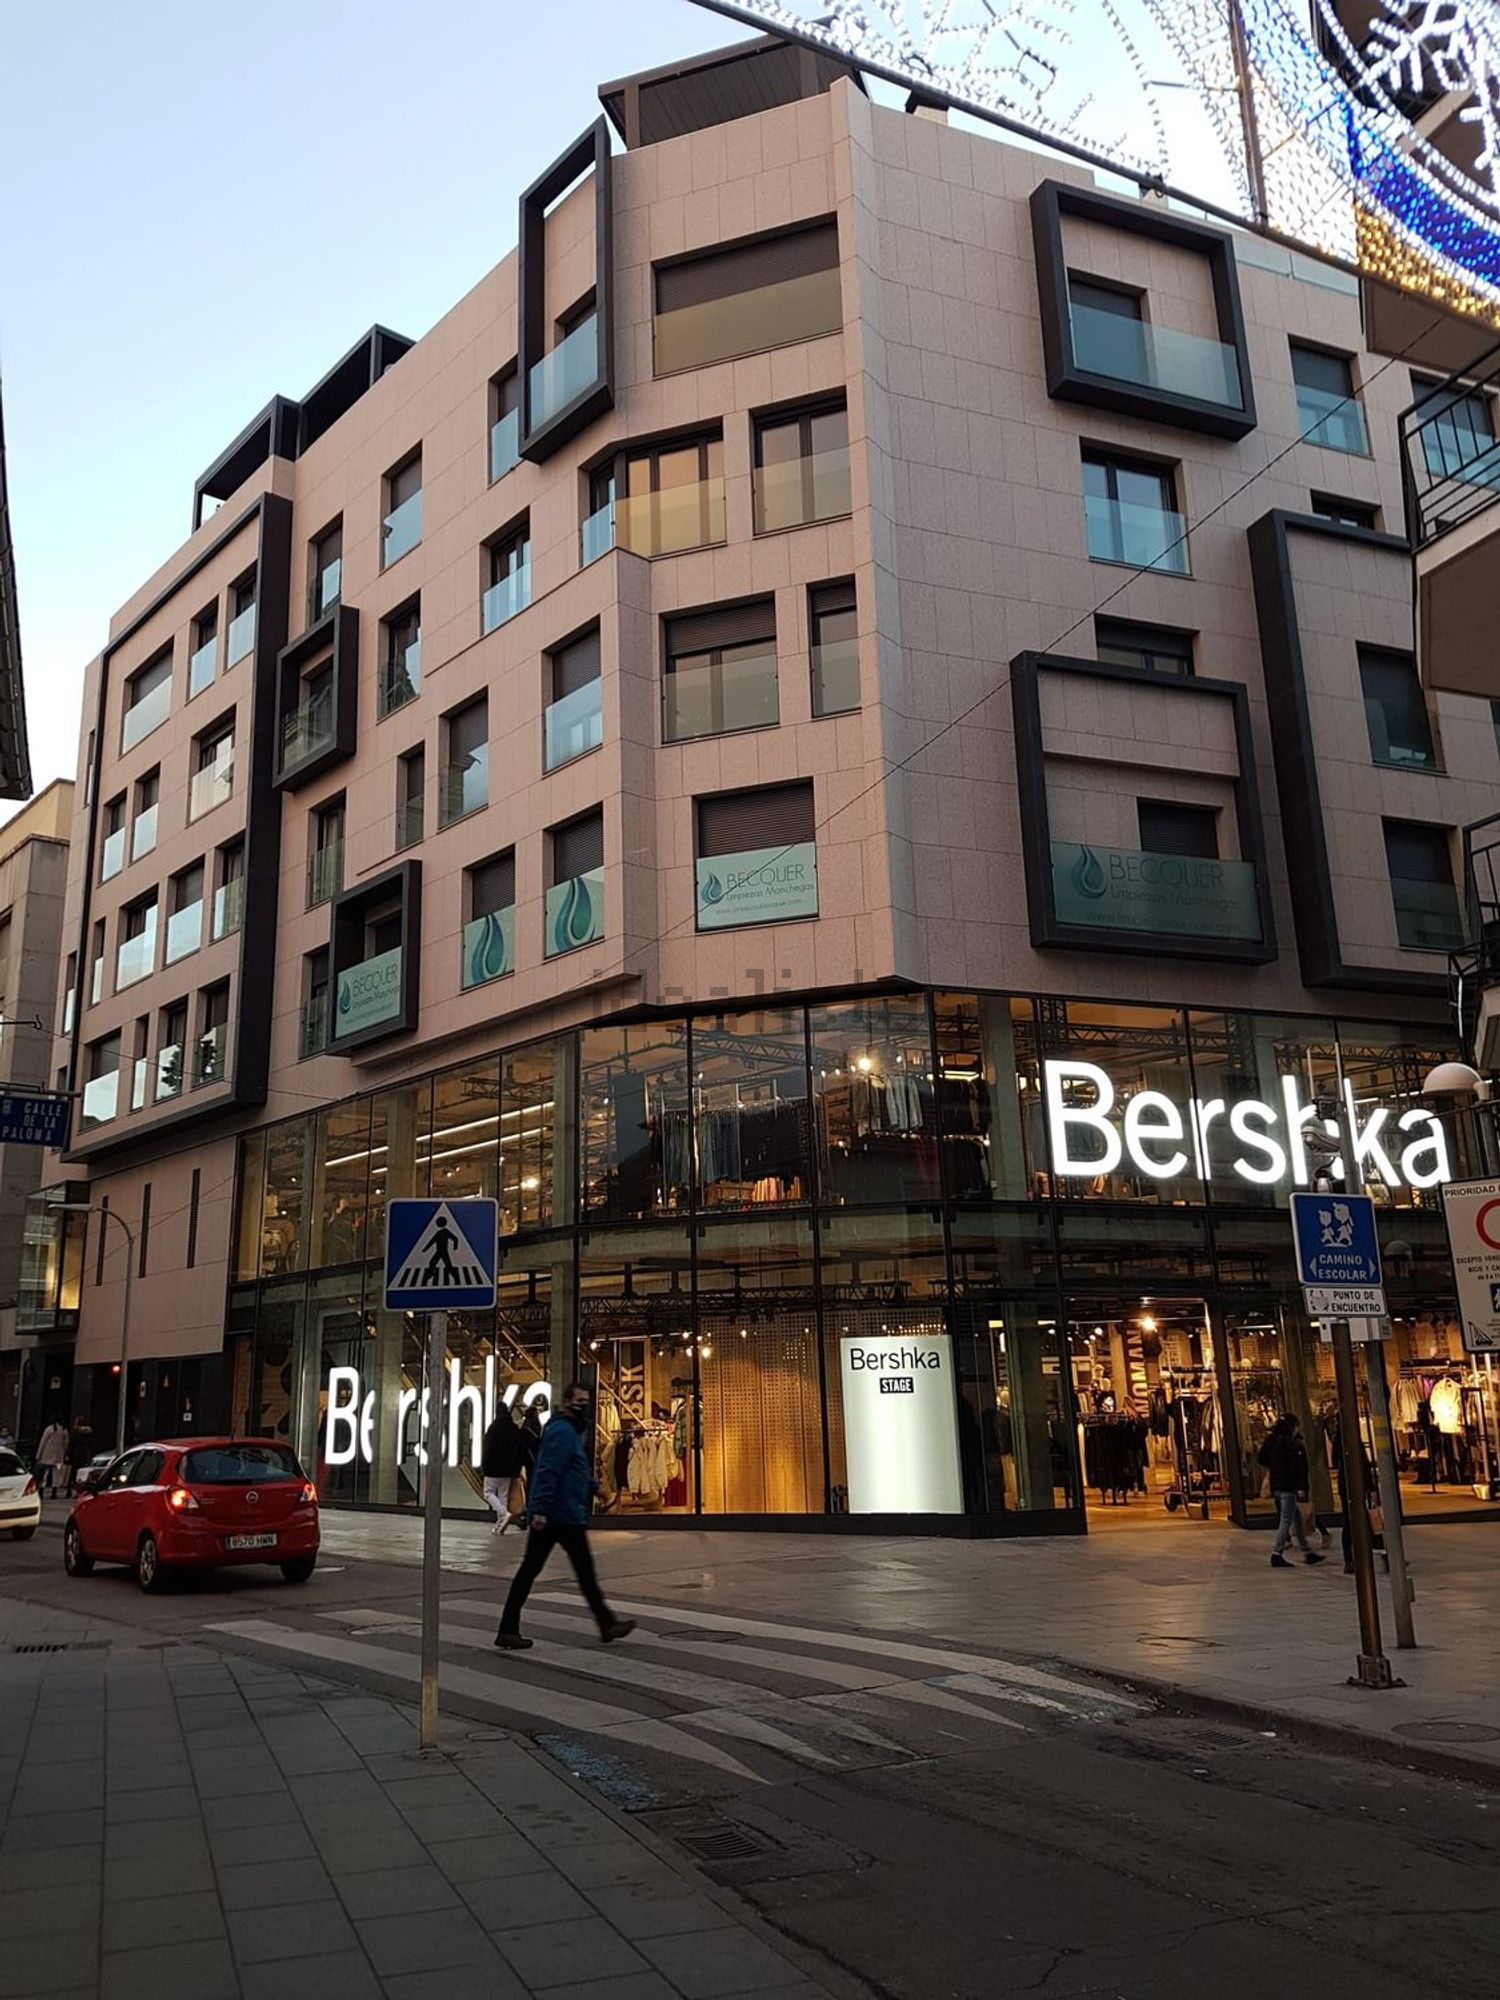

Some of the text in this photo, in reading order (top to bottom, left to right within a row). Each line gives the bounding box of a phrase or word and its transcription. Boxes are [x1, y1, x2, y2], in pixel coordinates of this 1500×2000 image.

[726, 864, 805, 889] BECQUER
[1109, 854, 1225, 889] BECQUER
[24, 1102, 62, 1116] CALLE
[23, 1114, 56, 1128] DE LA
[1044, 1059, 1451, 1188] Bershka
[2, 1126, 51, 1141] PALOMA
[1444, 1185, 1496, 1197] PRIORIDAD
[1319, 1254, 1362, 1266] CAMINO
[1318, 1269, 1367, 1281] ESCOLAR
[1333, 1290, 1375, 1300] PUNTO DE
[1331, 1303, 1381, 1312] ENCUENTRO
[850, 1346, 941, 1370] Bershka
[1126, 1329, 1150, 1419] WOMAN
[621, 1364, 643, 1419] BSK
[881, 1378, 912, 1392] STAGE
